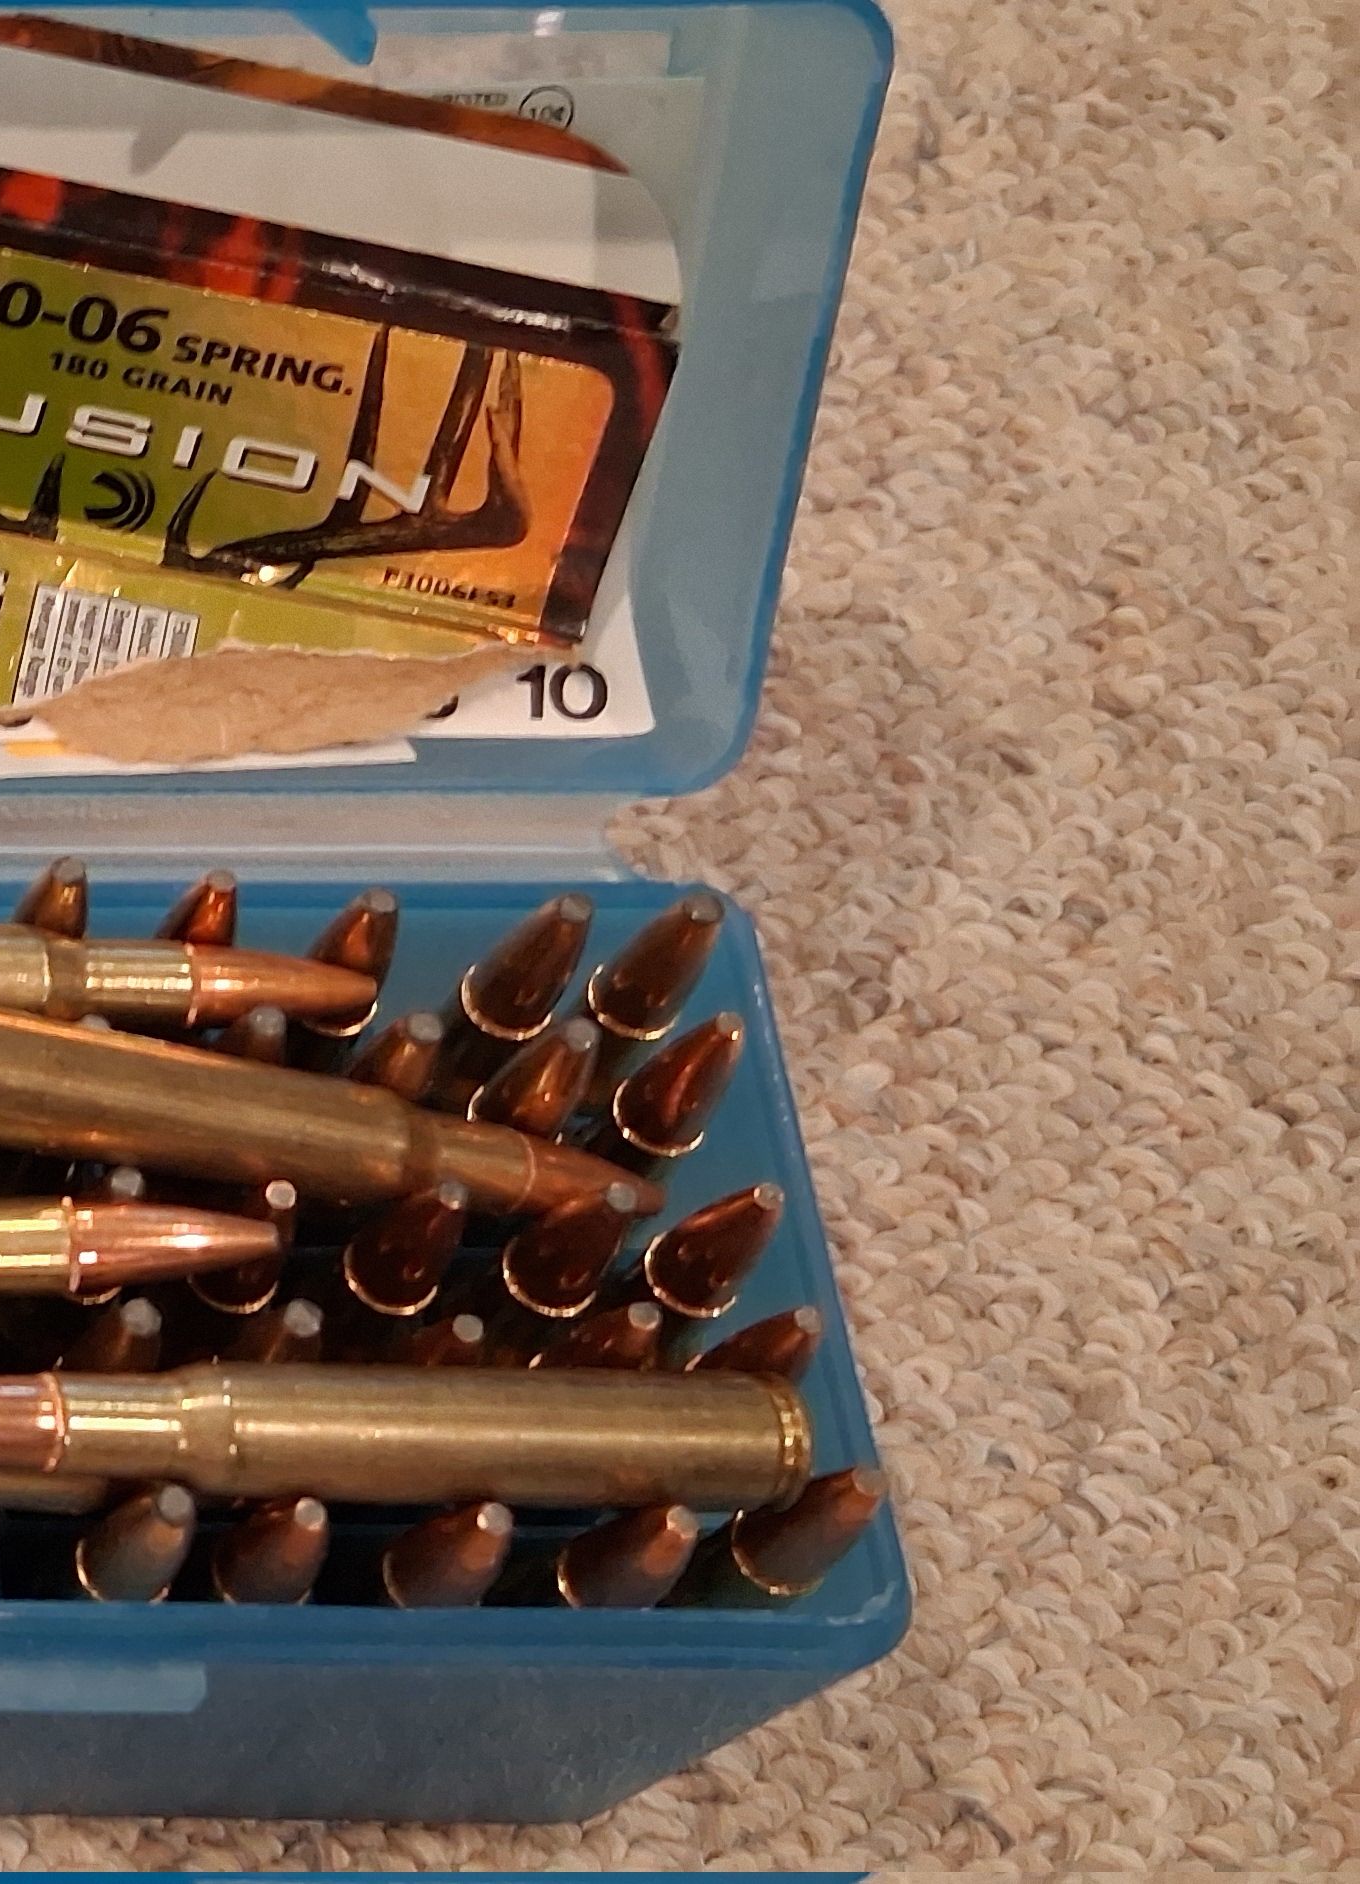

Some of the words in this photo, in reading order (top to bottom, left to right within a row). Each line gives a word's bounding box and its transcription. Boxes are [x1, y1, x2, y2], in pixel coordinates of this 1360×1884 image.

[49, 349, 109, 382] 180
[121, 364, 234, 406] GRAIN
[174, 332, 354, 397] SPRING.
[515, 664, 609, 720] 10
